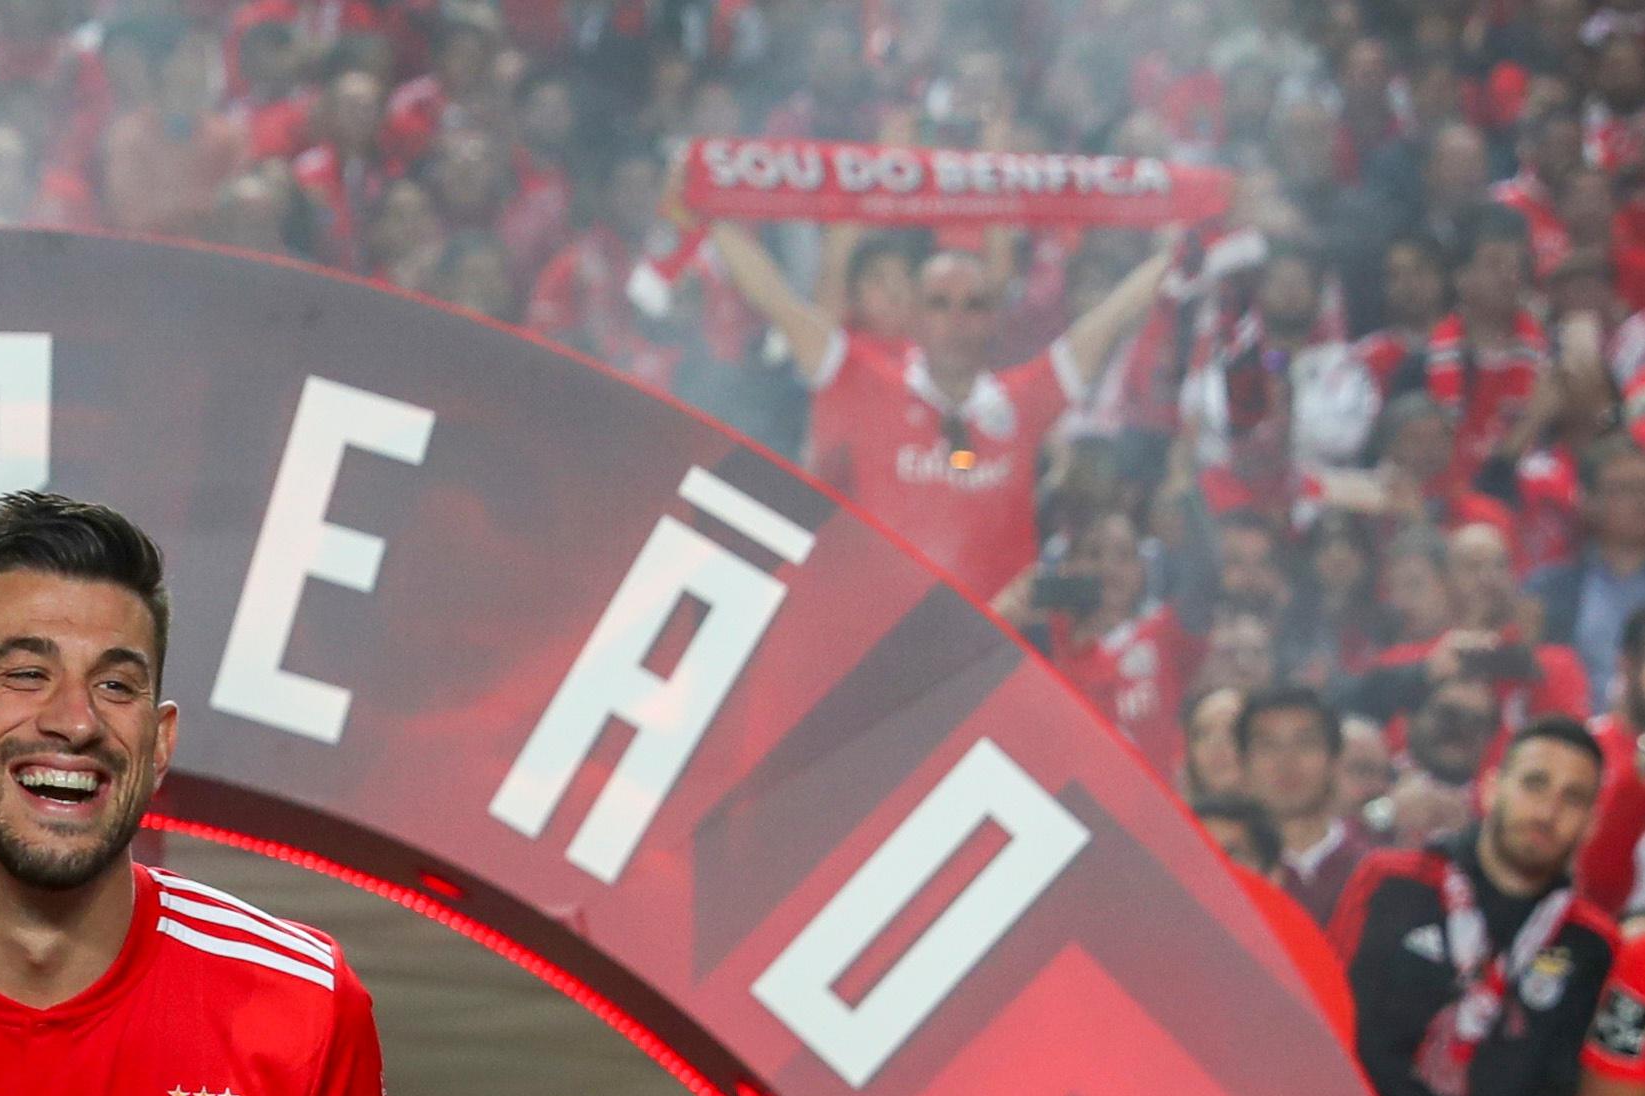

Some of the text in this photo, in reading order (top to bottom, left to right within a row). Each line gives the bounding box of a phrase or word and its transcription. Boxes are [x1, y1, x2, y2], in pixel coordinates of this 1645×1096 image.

[701, 139, 1172, 196] SOU DO BENFICA
